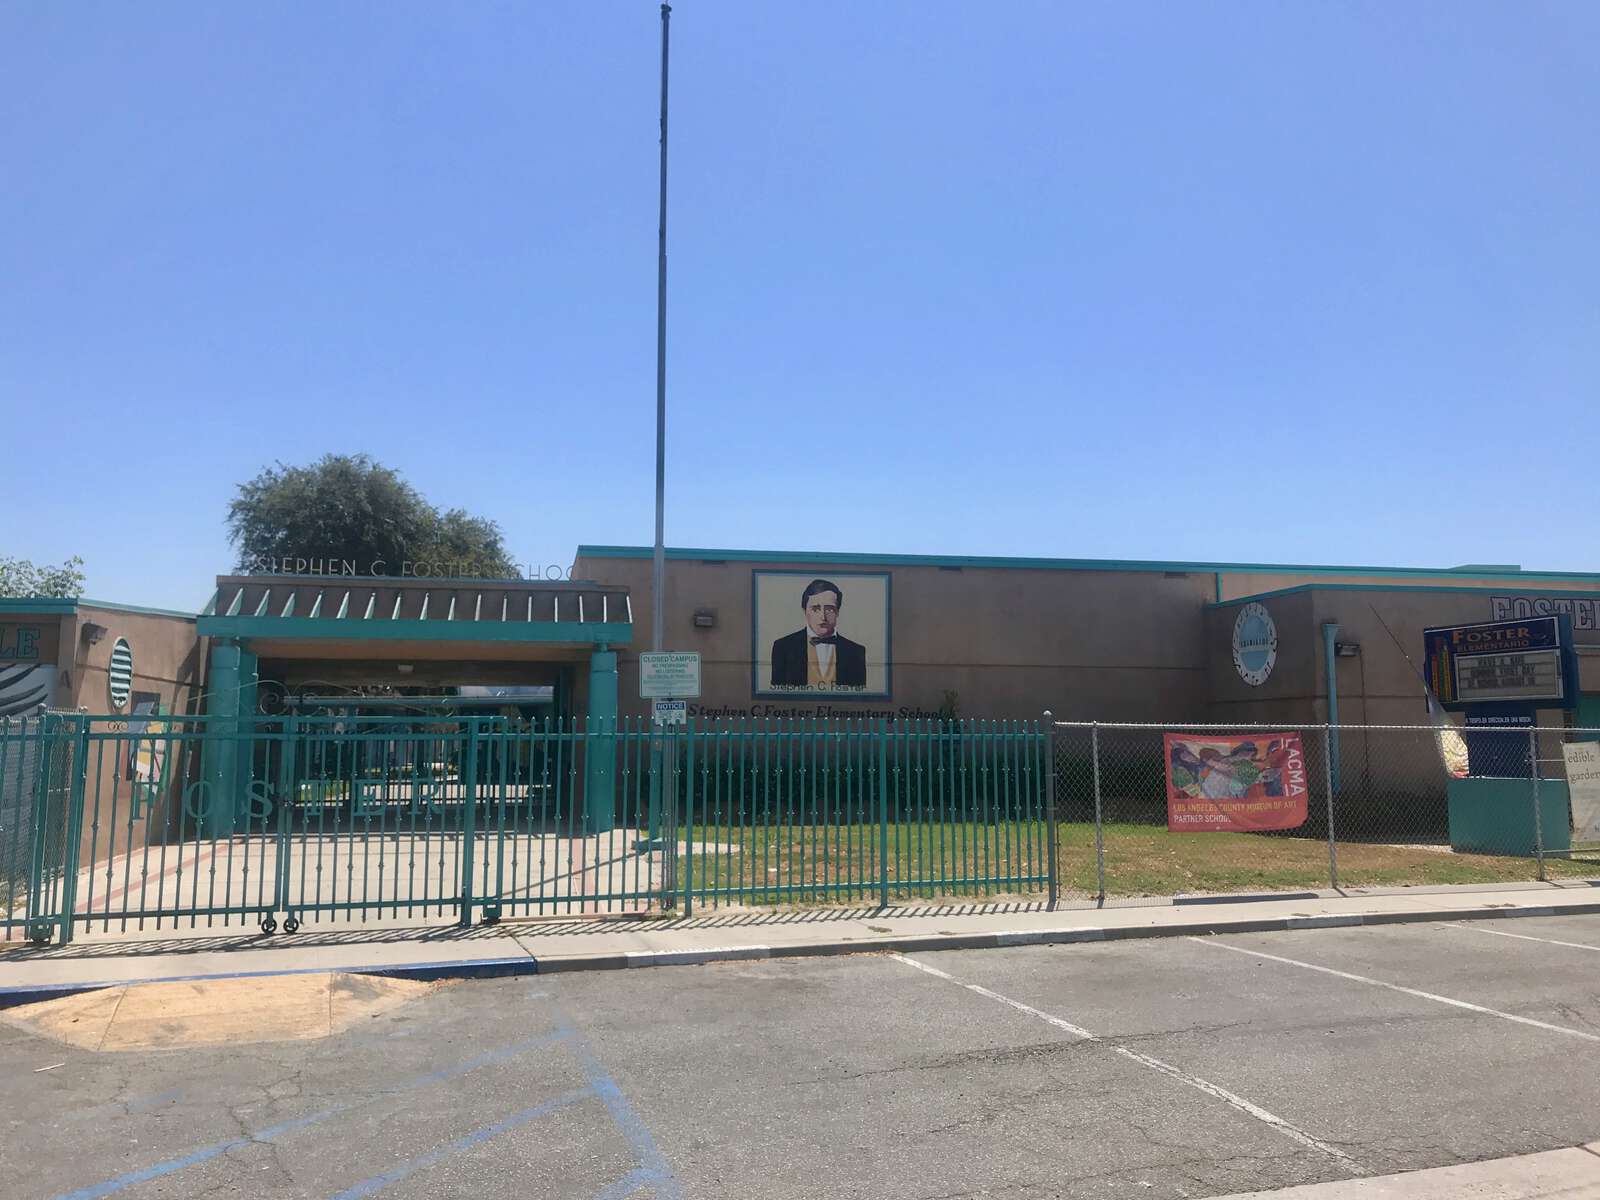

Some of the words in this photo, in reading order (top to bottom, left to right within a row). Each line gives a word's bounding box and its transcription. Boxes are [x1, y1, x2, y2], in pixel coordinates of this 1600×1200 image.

[257, 556, 355, 576] STEPHEN
[402, 560, 481, 578] FOSTER
[1490, 597, 1600, 630] FOSTE
[1452, 627, 1530, 644] FOSTER
[688, 704, 746, 721] Stephen
[815, 705, 894, 722] Elementary
[1567, 752, 1594, 763] edible
[1285, 738, 1306, 796] LACMA
[1173, 804, 1186, 812] LOS
[1246, 804, 1271, 813] MUSEUM
[1284, 801, 1296, 809] ART
[1174, 814, 1203, 823] PARTNER
[1204, 814, 1231, 823] SCHOOL
